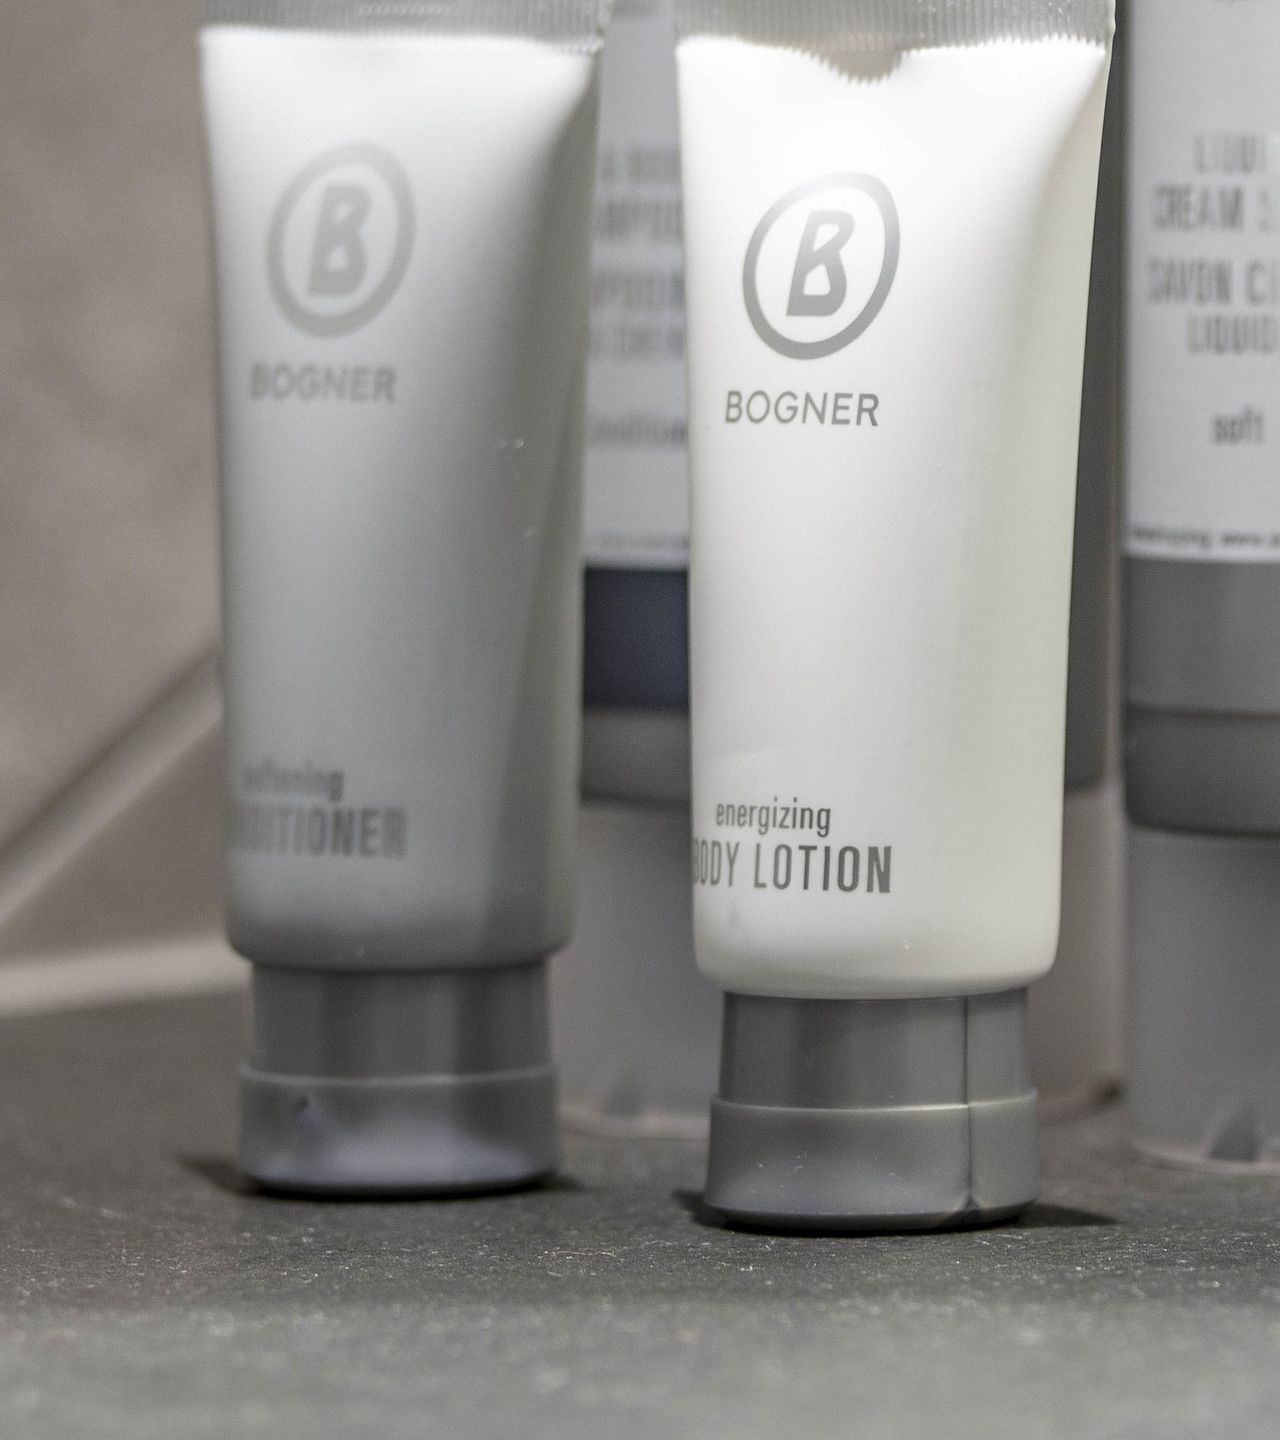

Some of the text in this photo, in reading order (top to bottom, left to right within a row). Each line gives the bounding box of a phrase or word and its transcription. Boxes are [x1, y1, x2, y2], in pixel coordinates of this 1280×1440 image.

[787, 210, 854, 317] B
[251, 363, 396, 403] BOGNER
[725, 390, 879, 426] BOGNER
[716, 797, 831, 837] energizing
[754, 842, 892, 893] LOTION
